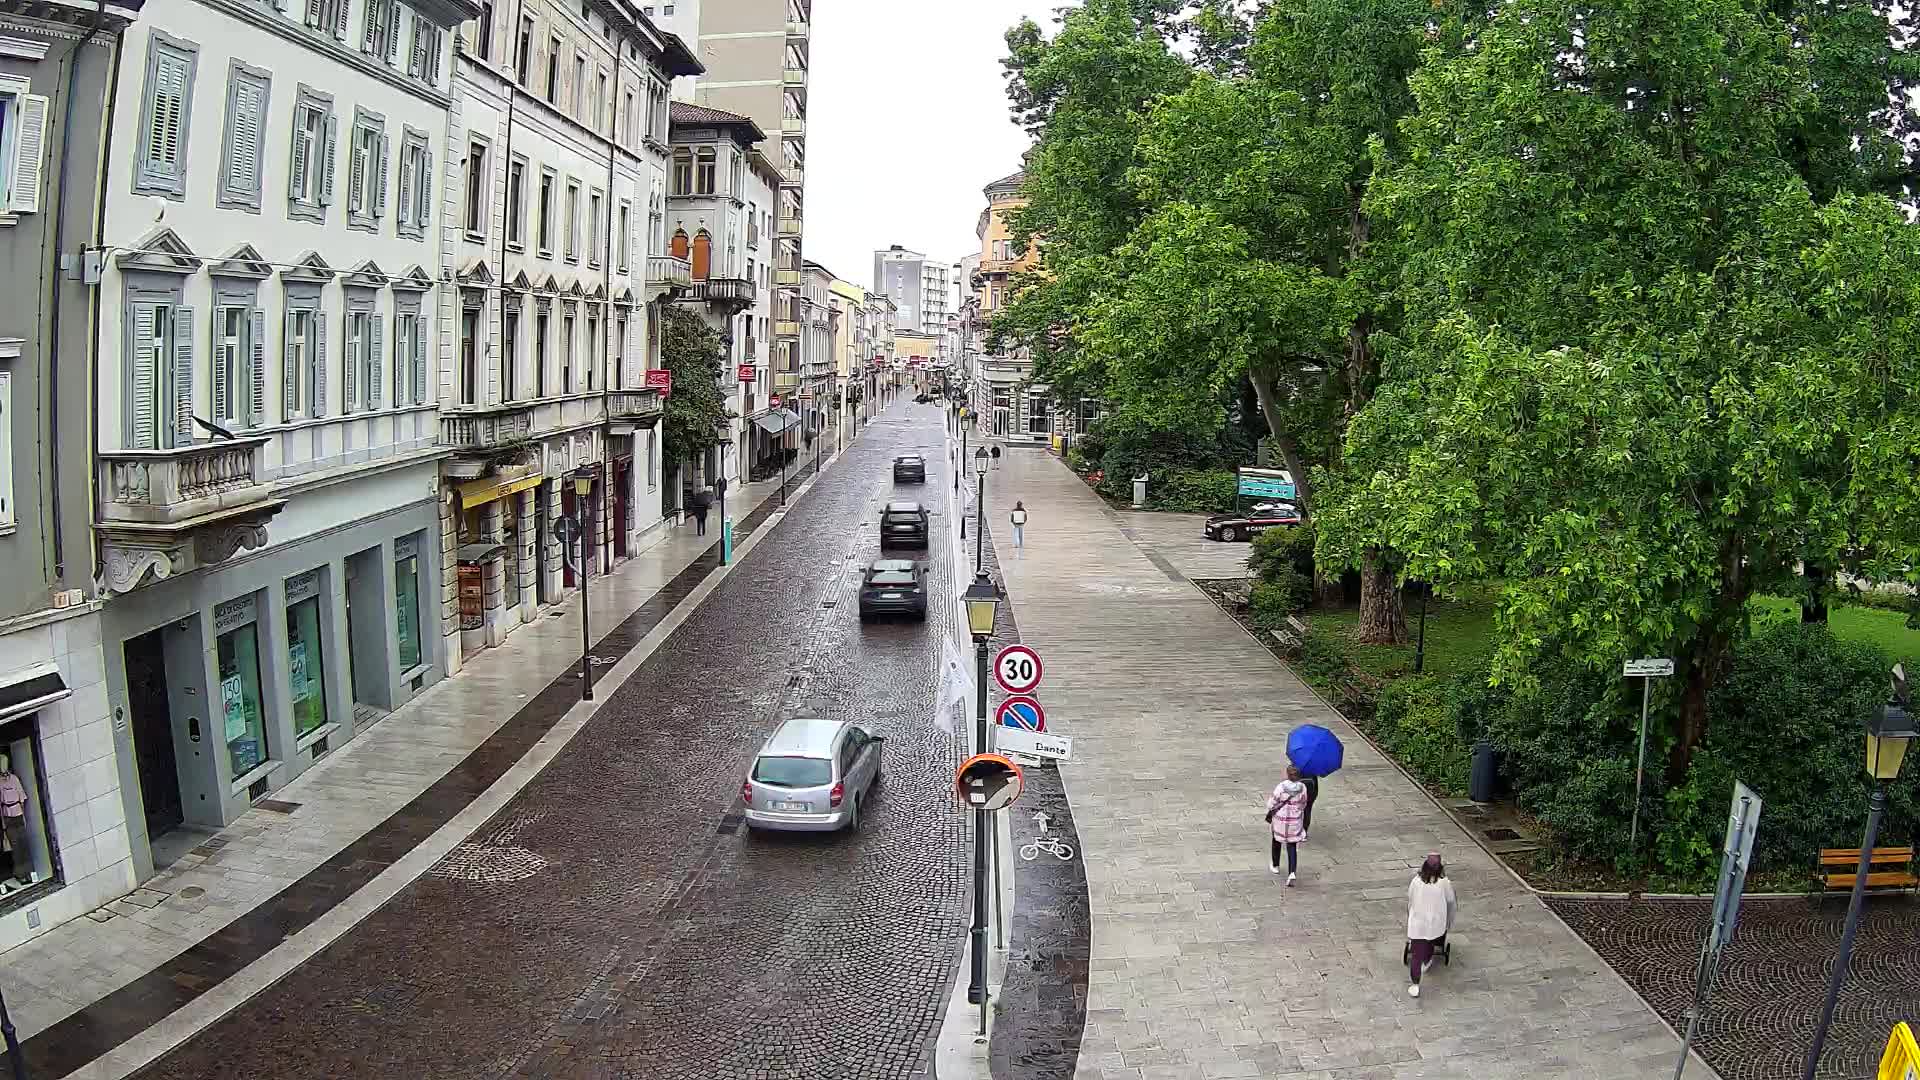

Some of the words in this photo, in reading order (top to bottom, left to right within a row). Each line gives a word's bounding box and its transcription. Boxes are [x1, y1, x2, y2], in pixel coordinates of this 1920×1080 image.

[1005, 659, 1032, 680] 30
[221, 678, 241, 701] 130
[1035, 743, 1066, 755] Dante
